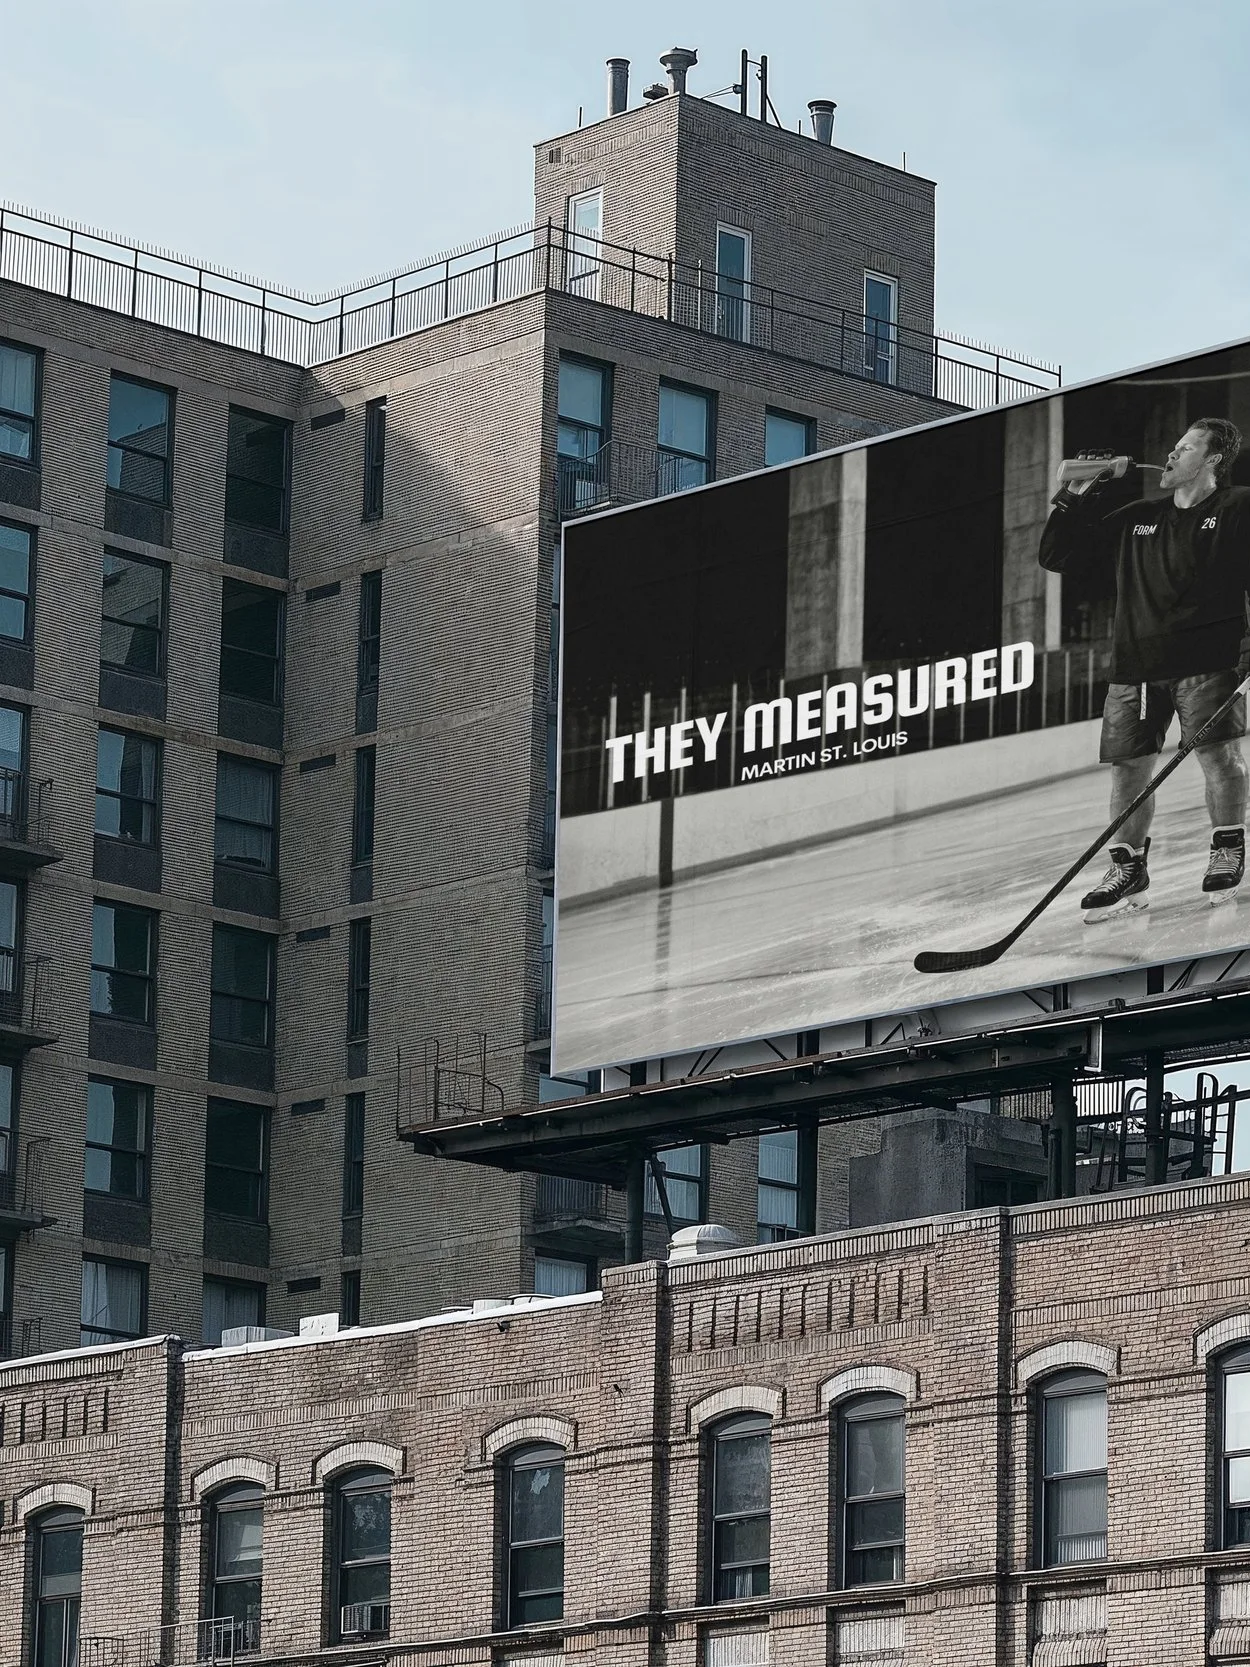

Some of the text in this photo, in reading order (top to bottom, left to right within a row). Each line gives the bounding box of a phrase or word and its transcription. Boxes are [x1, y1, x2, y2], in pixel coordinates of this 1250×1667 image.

[1133, 524, 1157, 536] FORM
[1201, 517, 1216, 529] 26
[605, 641, 1034, 783] THEY MEASURED
[741, 731, 908, 781] MARTIN ST. LOUIS
